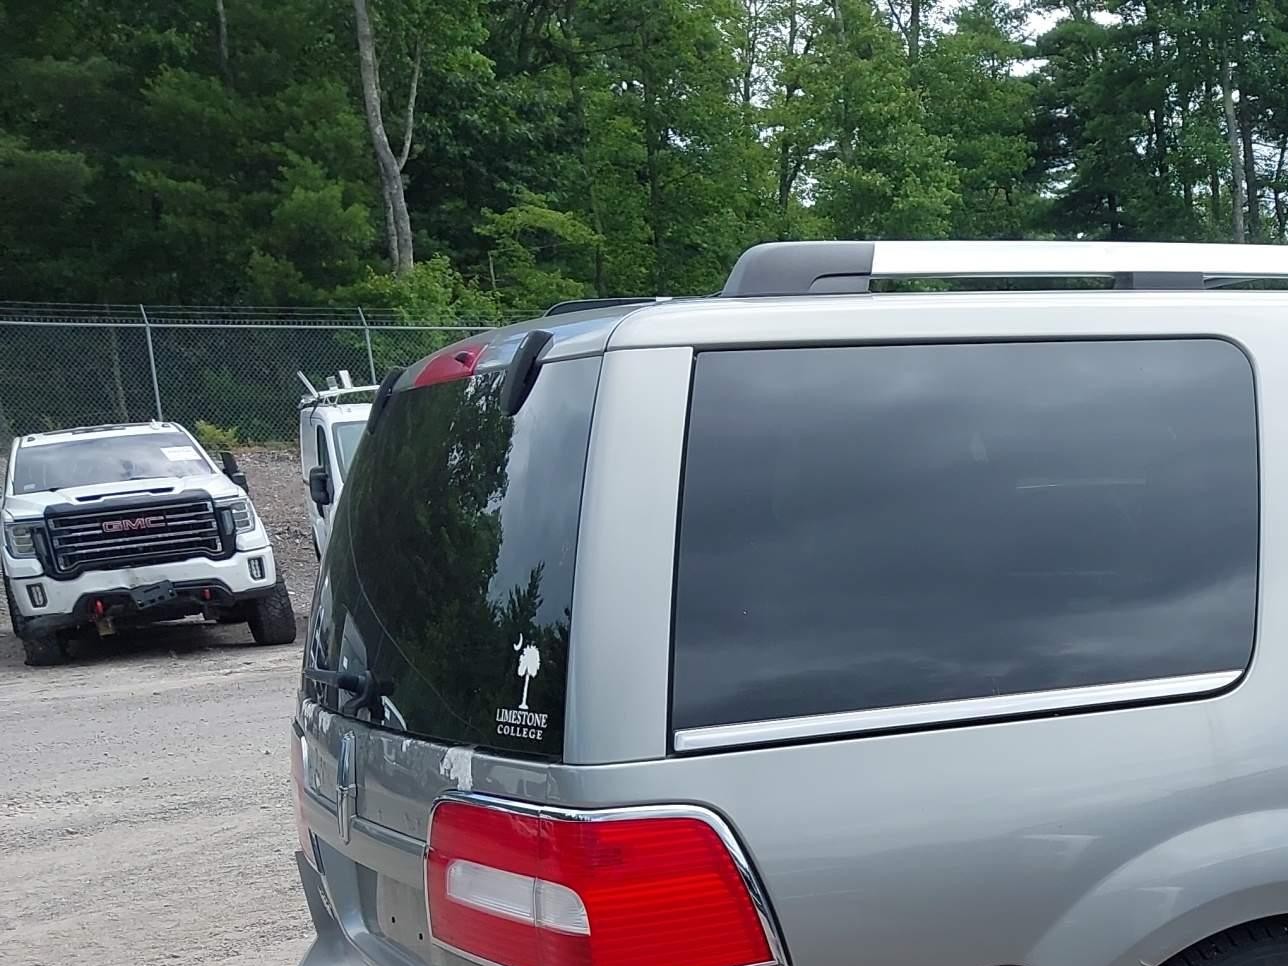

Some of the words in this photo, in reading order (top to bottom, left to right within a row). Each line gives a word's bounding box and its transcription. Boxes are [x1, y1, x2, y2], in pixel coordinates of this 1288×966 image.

[102, 515, 166, 533] GMC
[496, 708, 548, 728] LIMESTONE
[497, 724, 543, 740] COLLEGE
